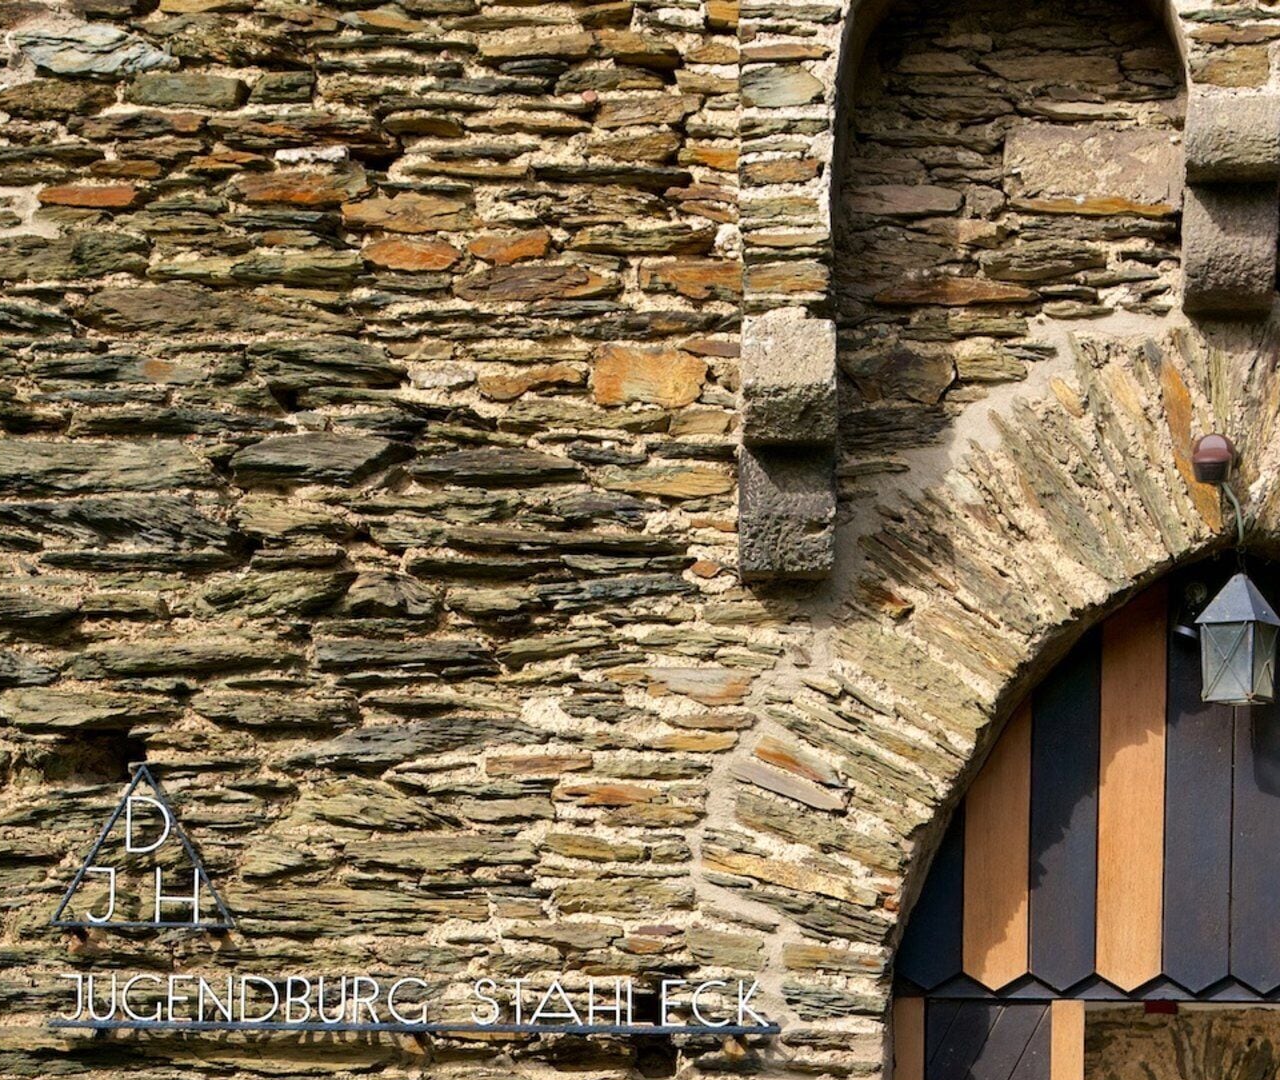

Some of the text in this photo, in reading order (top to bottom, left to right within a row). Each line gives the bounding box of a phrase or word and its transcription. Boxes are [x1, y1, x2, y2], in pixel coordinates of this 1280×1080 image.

[126, 796, 170, 853] D
[86, 866, 199, 924] J H
[59, 973, 770, 1028] JUGENDBURG STAHLECK
